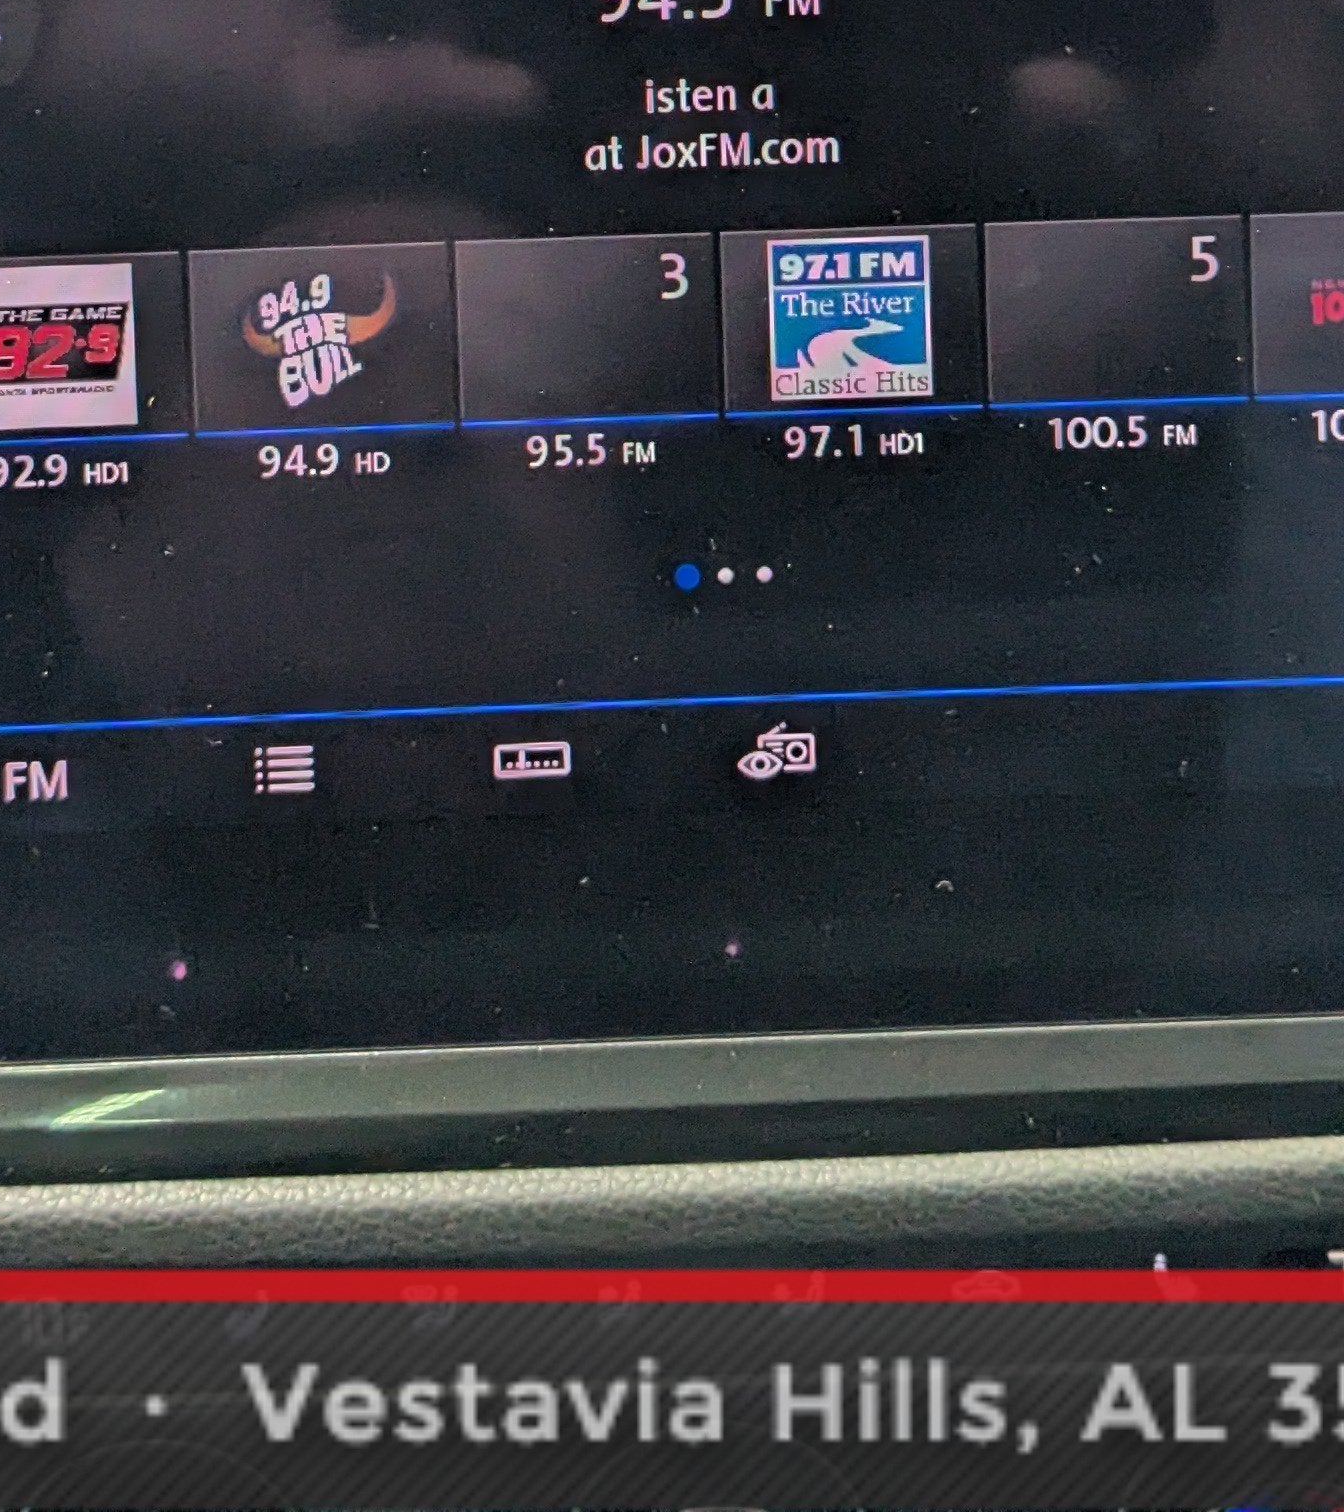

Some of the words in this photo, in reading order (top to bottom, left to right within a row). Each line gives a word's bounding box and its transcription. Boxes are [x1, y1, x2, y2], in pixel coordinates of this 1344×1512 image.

[645, 78, 738, 114] isten
[750, 83, 775, 111] a
[584, 135, 624, 172] at
[635, 131, 840, 170] JoxFM.com
[659, 252, 690, 300] 3
[778, 253, 851, 281] 97.1
[859, 251, 916, 278] FM
[1189, 234, 1220, 283] 5
[50, 306, 123, 321] GAME
[258, 273, 331, 330] 94.9
[781, 292, 835, 318] The
[842, 291, 915, 317] River
[273, 312, 347, 356] THE
[278, 343, 363, 408] BULL
[774, 372, 867, 398] Classic
[875, 369, 930, 395] Hits
[526, 432, 607, 469] 95.5
[622, 441, 657, 465] FM
[783, 424, 864, 460] 97.1
[879, 430, 924, 457] HD1
[1048, 415, 1148, 451] 100.5
[1163, 422, 1198, 447] FM
[83, 461, 129, 486] HD1
[258, 443, 339, 478] 94.9
[355, 451, 391, 474] HD
[3, 758, 69, 804] FM
